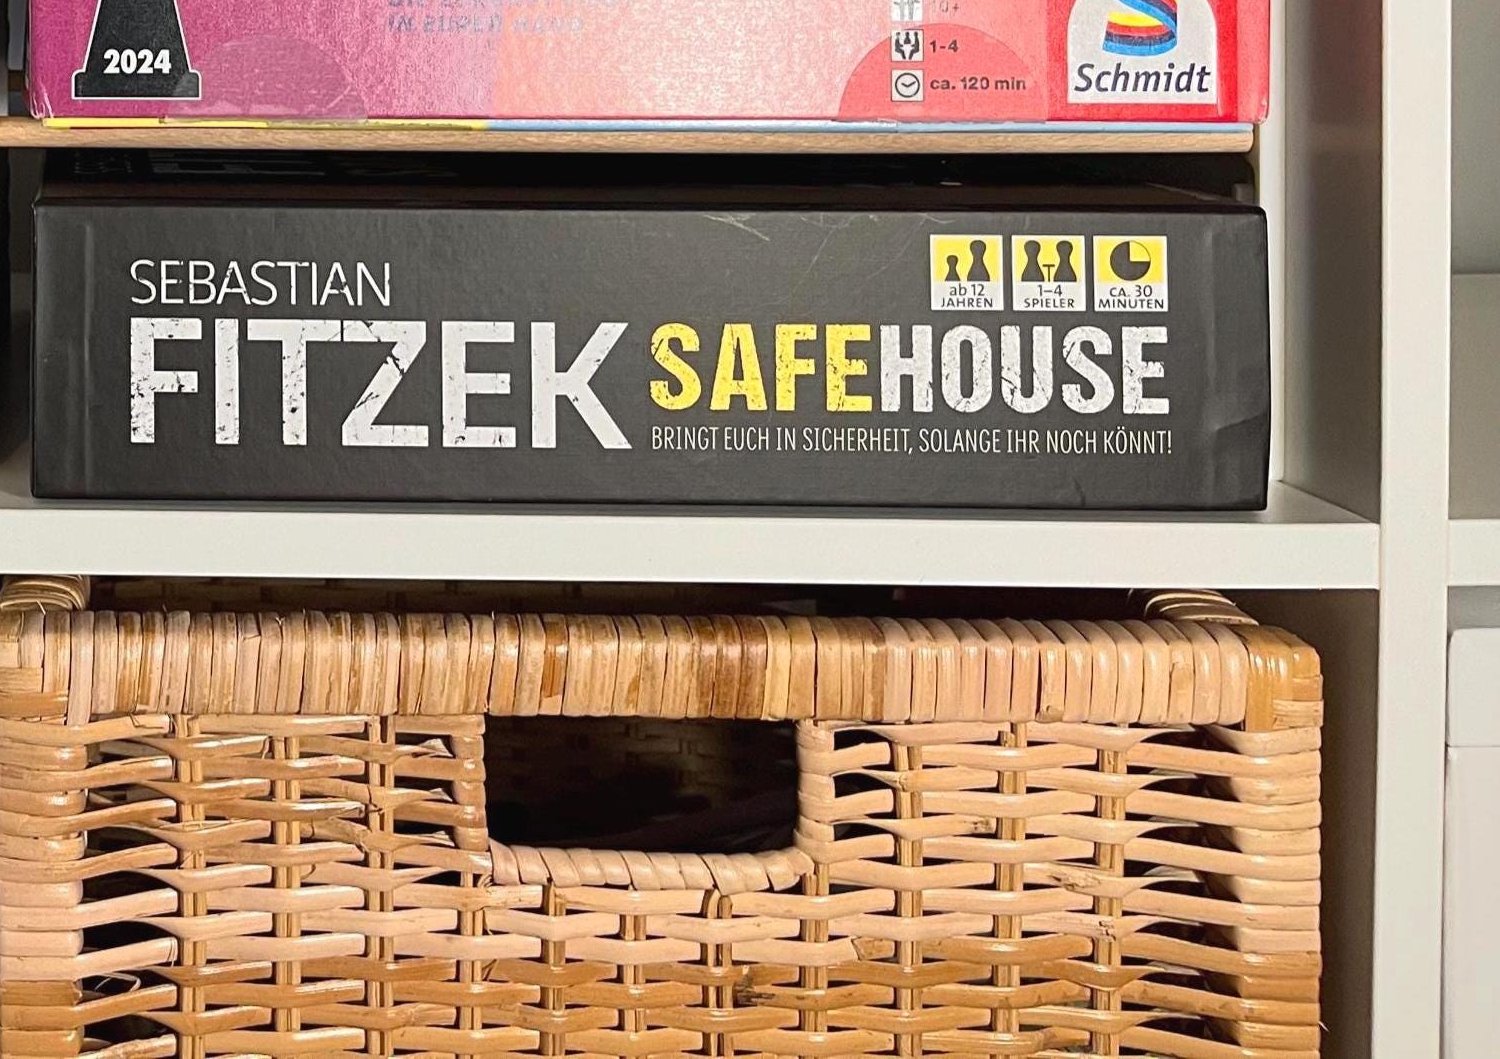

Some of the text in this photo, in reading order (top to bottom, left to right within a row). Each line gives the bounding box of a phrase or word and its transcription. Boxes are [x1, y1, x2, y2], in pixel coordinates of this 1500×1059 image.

[929, 40, 959, 53] 1-4
[103, 48, 171, 74] 2024
[930, 76, 1026, 90] ca. 120 min
[1074, 61, 1211, 95] Schmidt
[129, 259, 391, 307] SEBASTIAN
[949, 283, 986, 296] ab 12
[1109, 285, 1153, 297] CA. 30
[941, 297, 993, 308] JAHREN
[1023, 297, 1075, 308] SPIELER
[1098, 298, 1165, 309] MINUTEN
[649, 322, 1171, 416] SAFEHOUSE
[129, 316, 633, 450] FITZEK
[651, 425, 1172, 455] BRINGT EUCH IN SICHERHEIT, SOLANGE IHR NOCH KÖNNT!
